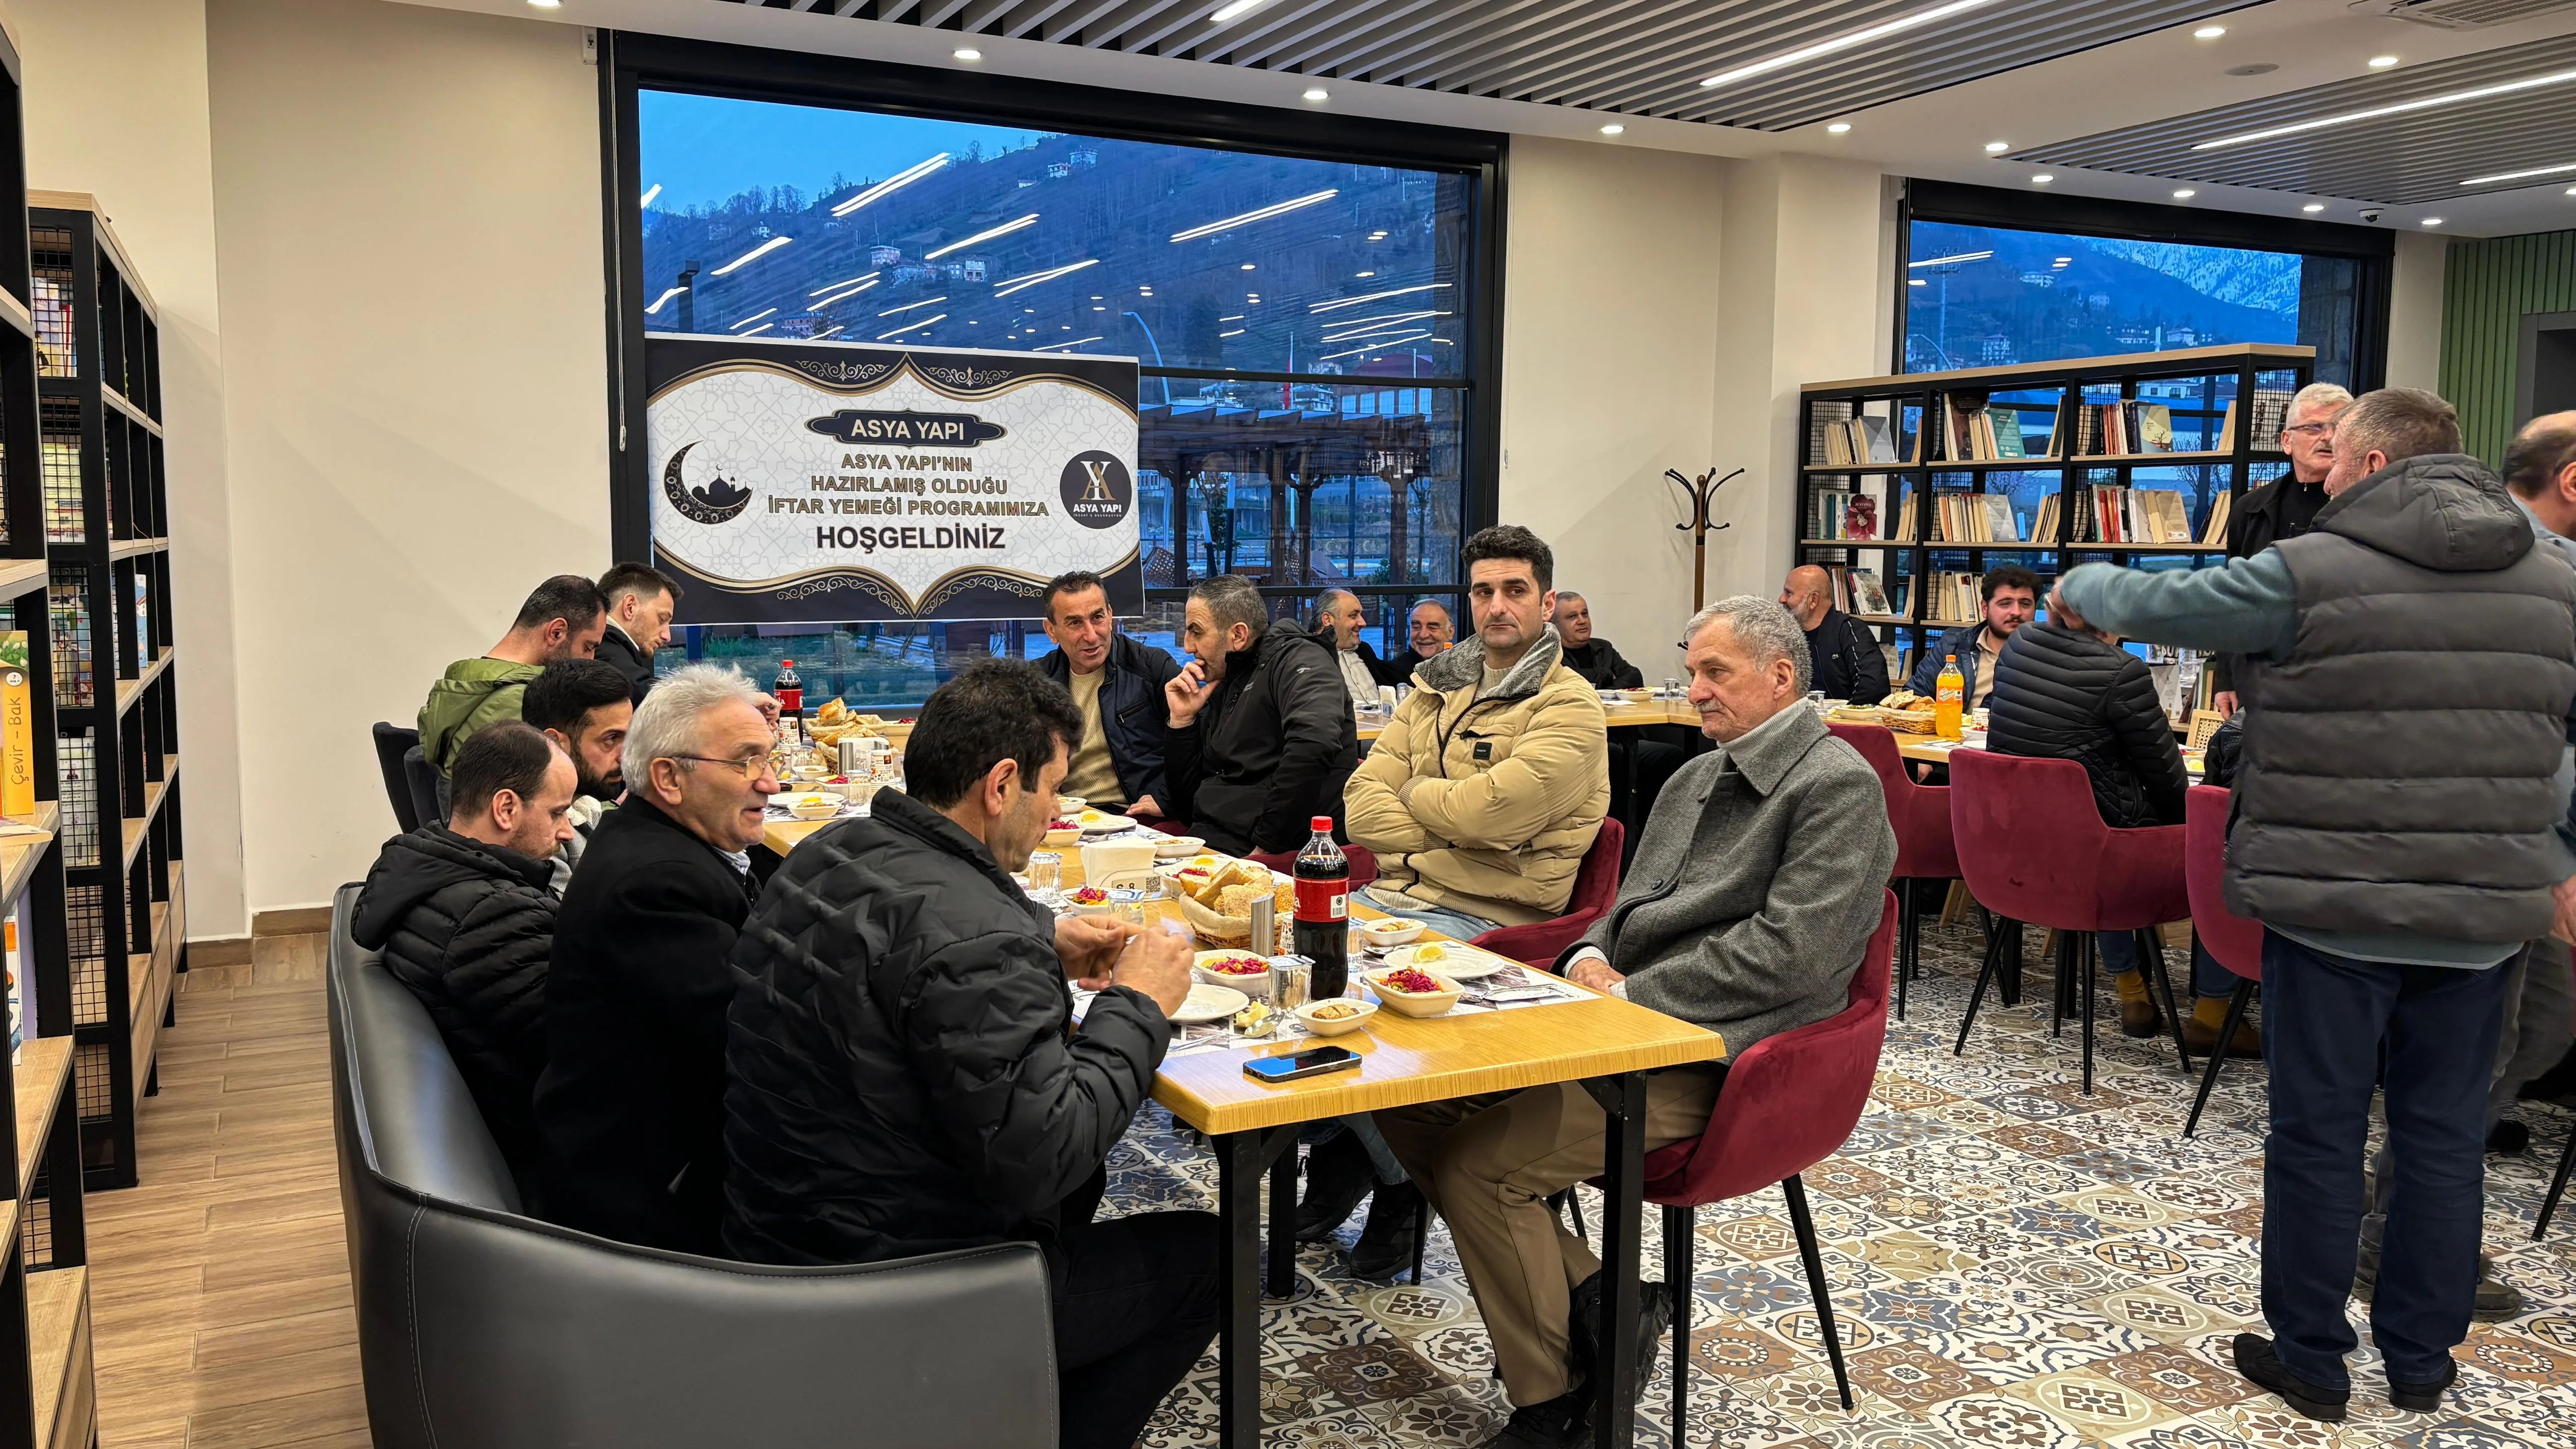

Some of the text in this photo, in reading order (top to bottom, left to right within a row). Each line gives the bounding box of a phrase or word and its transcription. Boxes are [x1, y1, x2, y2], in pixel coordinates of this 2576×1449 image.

[851, 419, 964, 441] ASYA YAPI
[841, 453, 973, 472] ASYA YAPI'NIN
[811, 475, 1007, 497] HAZIRLAMIŞ OLDUĞU
[768, 495, 1050, 516] İFTAR YEMEĞİ PROGRAMIMIZA
[1073, 504, 1122, 513] ASYA YAPI
[816, 522, 1006, 554] HOŞGELDİNİZ
[8, 697, 22, 727] Bak
[9, 745, 29, 785] Çevir
